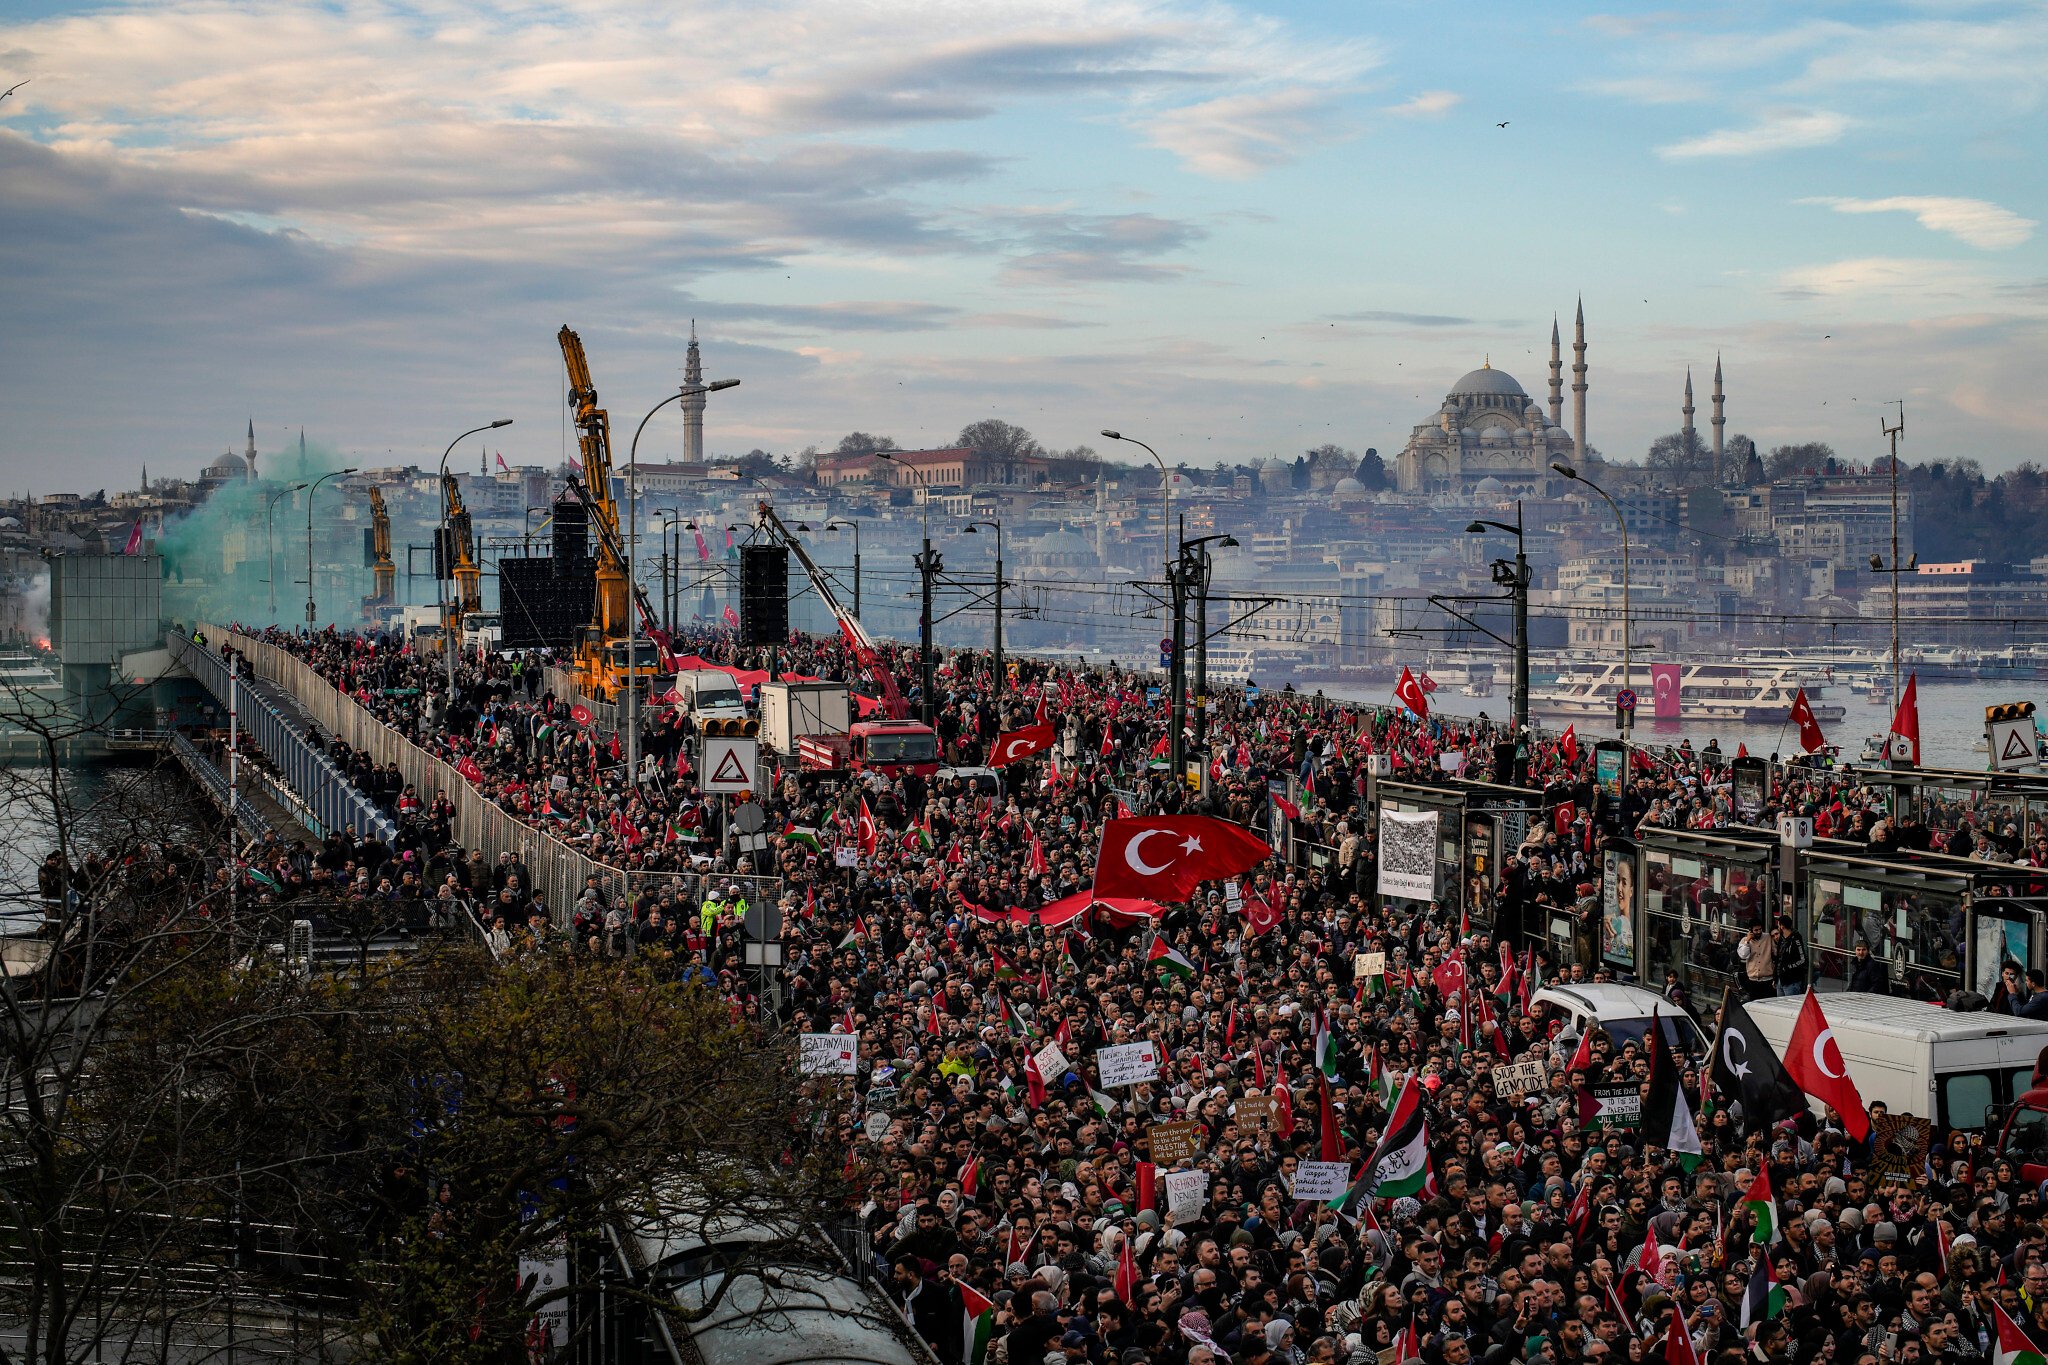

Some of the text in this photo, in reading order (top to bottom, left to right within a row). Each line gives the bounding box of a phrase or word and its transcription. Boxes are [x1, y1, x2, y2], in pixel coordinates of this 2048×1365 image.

[1494, 1063, 1537, 1080] STOP THE
[1496, 1075, 1543, 1096] GENOCIDE
[1594, 1087, 1638, 1097] FROM THE RIVER
[1617, 1097, 1627, 1105] THE
[1629, 1096, 1639, 1104] SEA
[1607, 1105, 1639, 1114] PALESTINE
[1597, 1112, 1640, 1124] WILL BE FREE
[1154, 1141, 1188, 1152] PALESTINE
[1174, 1149, 1190, 1157] FREE
